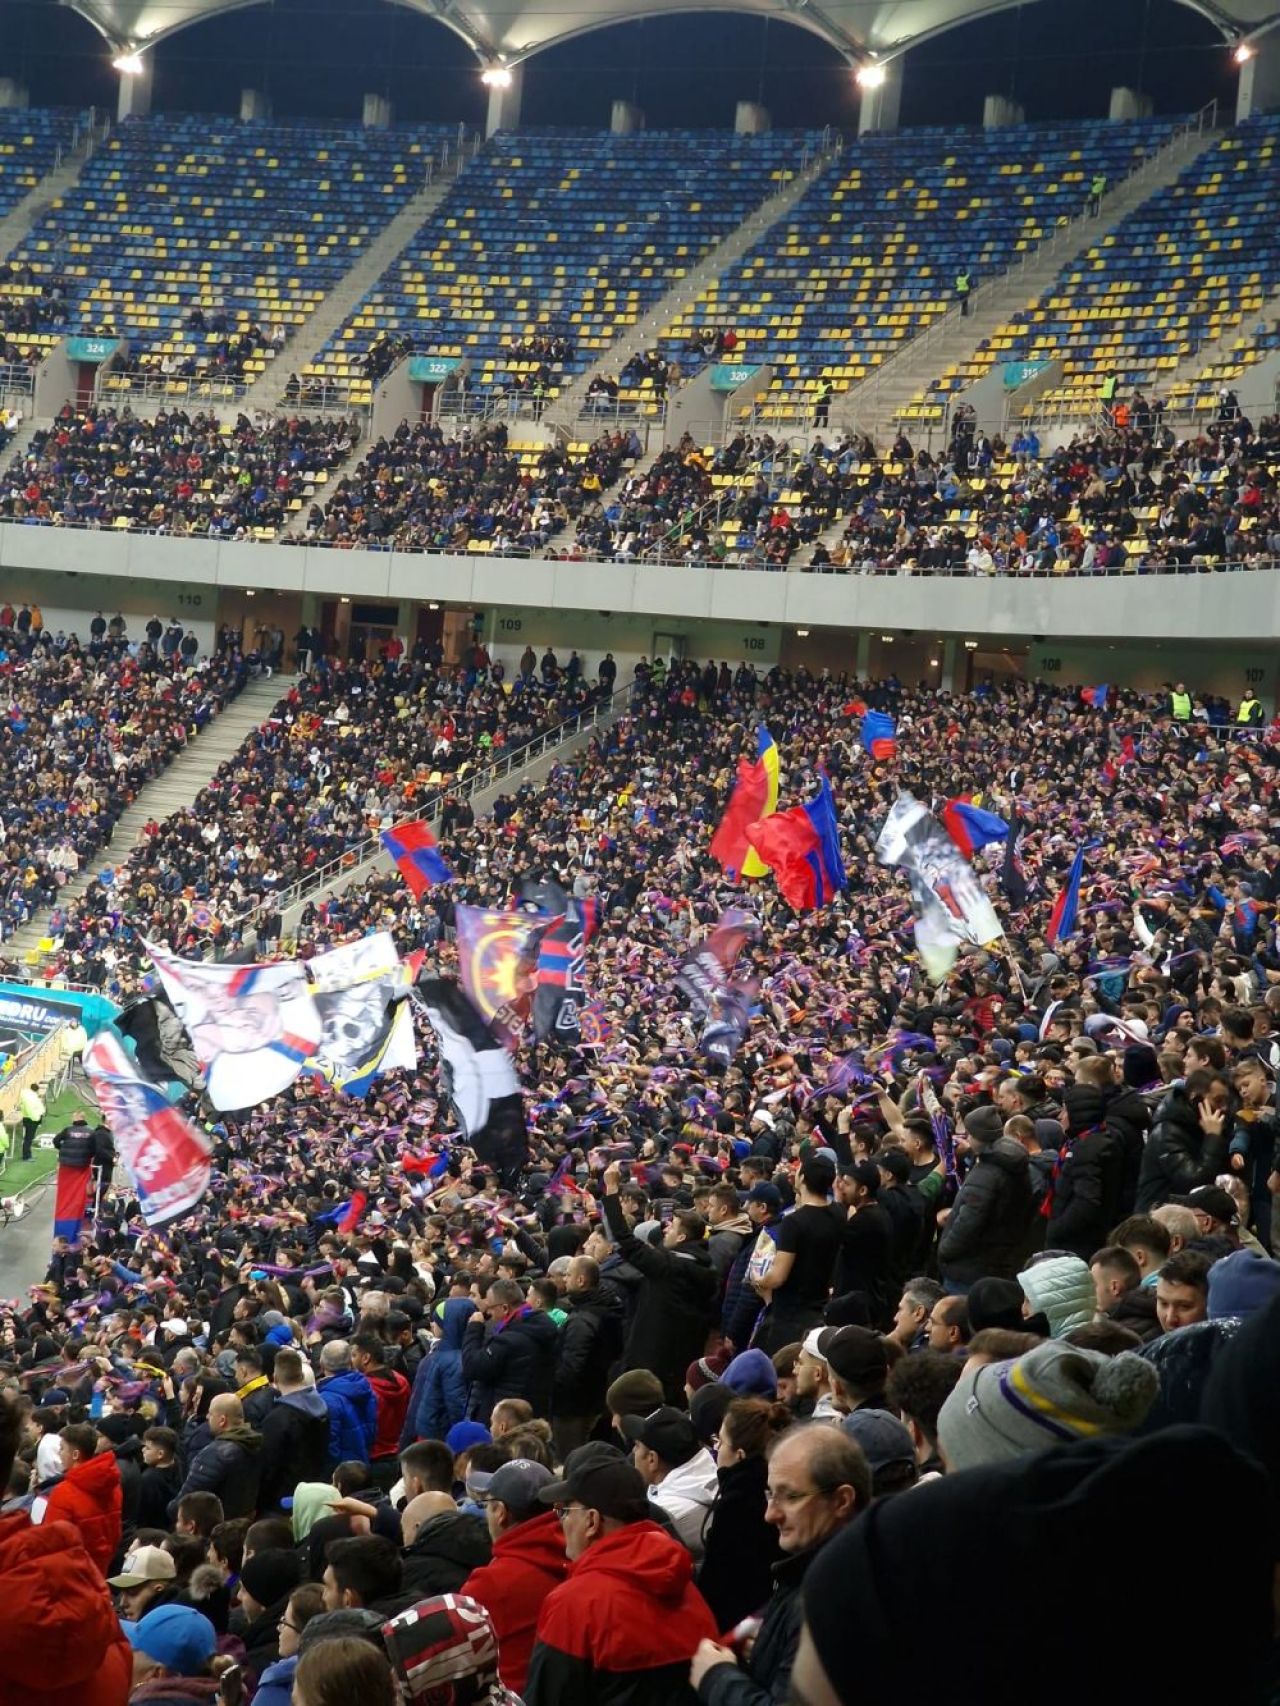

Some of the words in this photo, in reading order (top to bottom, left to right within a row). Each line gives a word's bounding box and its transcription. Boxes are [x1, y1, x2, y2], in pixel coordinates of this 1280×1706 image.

[86, 343, 105, 353] 324
[429, 363, 447, 374] 322
[729, 371, 748, 381] 320
[177, 594, 202, 607] 110
[500, 619, 522, 631] 109
[743, 638, 765, 650] 108
